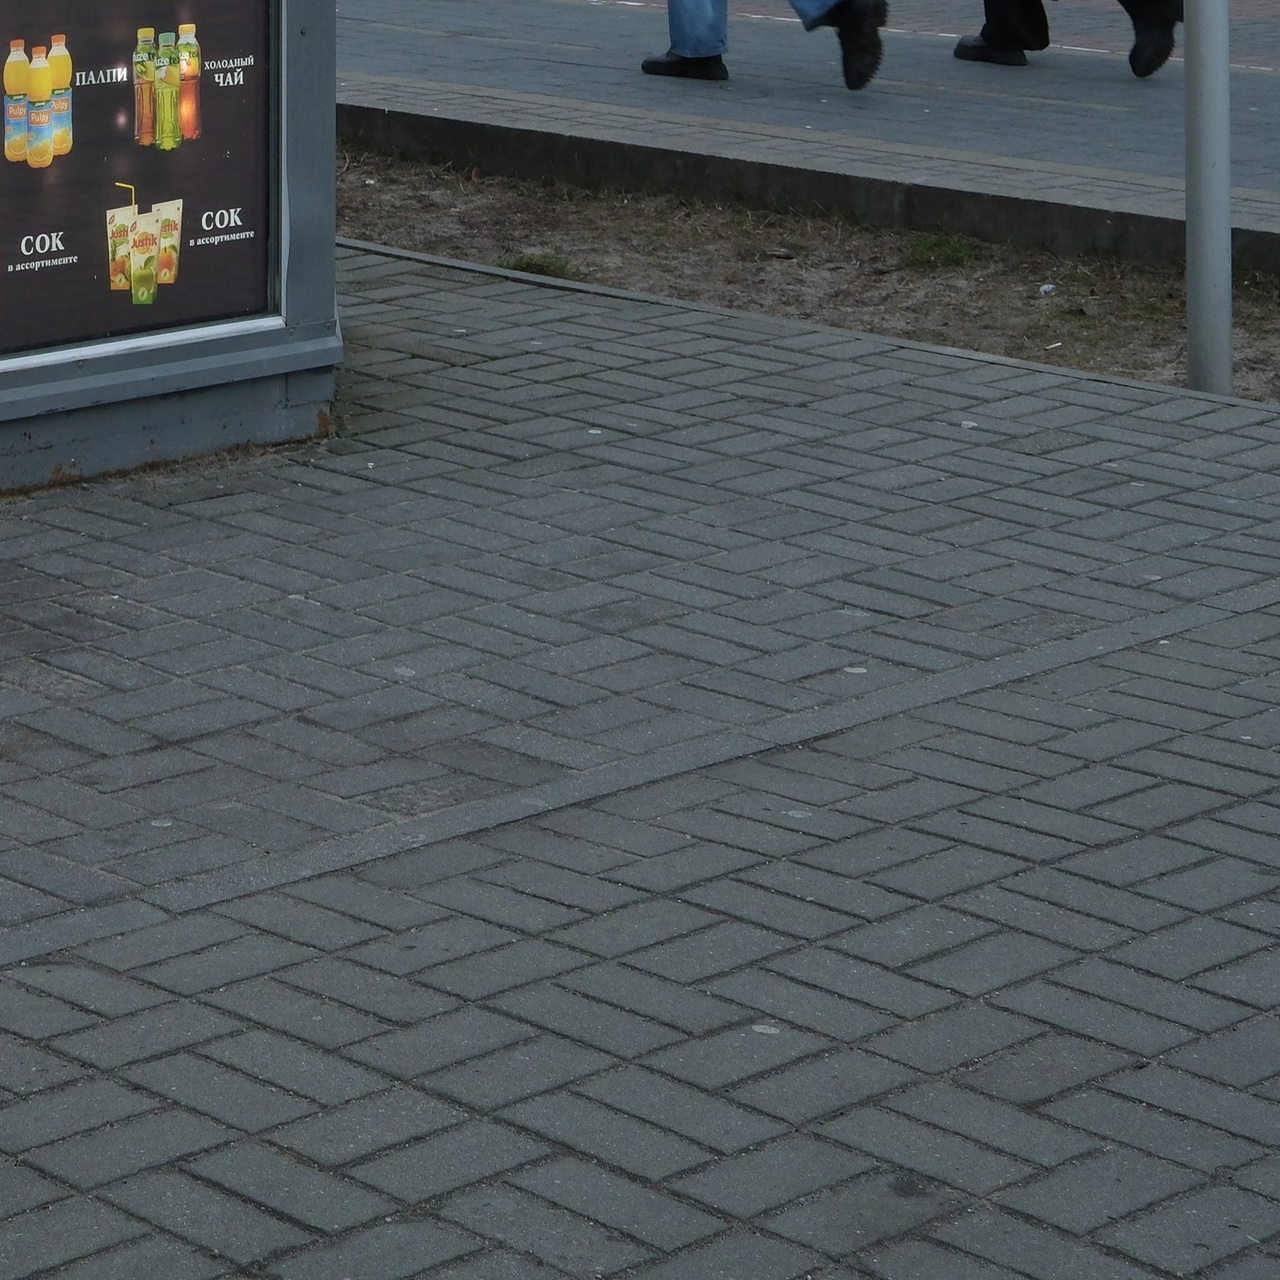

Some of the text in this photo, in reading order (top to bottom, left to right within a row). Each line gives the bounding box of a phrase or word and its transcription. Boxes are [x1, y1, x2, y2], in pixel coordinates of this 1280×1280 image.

[204, 55, 254, 70] ХОЛОДНЫЙ
[75, 67, 128, 88] ПАЛПИ
[214, 68, 244, 87] ЧАЙ
[9, 107, 26, 117] Pulpy
[31, 113, 49, 123] Pulpy
[202, 208, 242, 231] СОК
[21, 231, 65, 256] СОК
[131, 234, 157, 249] Justik
[189, 230, 254, 247] в ассортименте
[7, 255, 78, 273] в ассортименте
